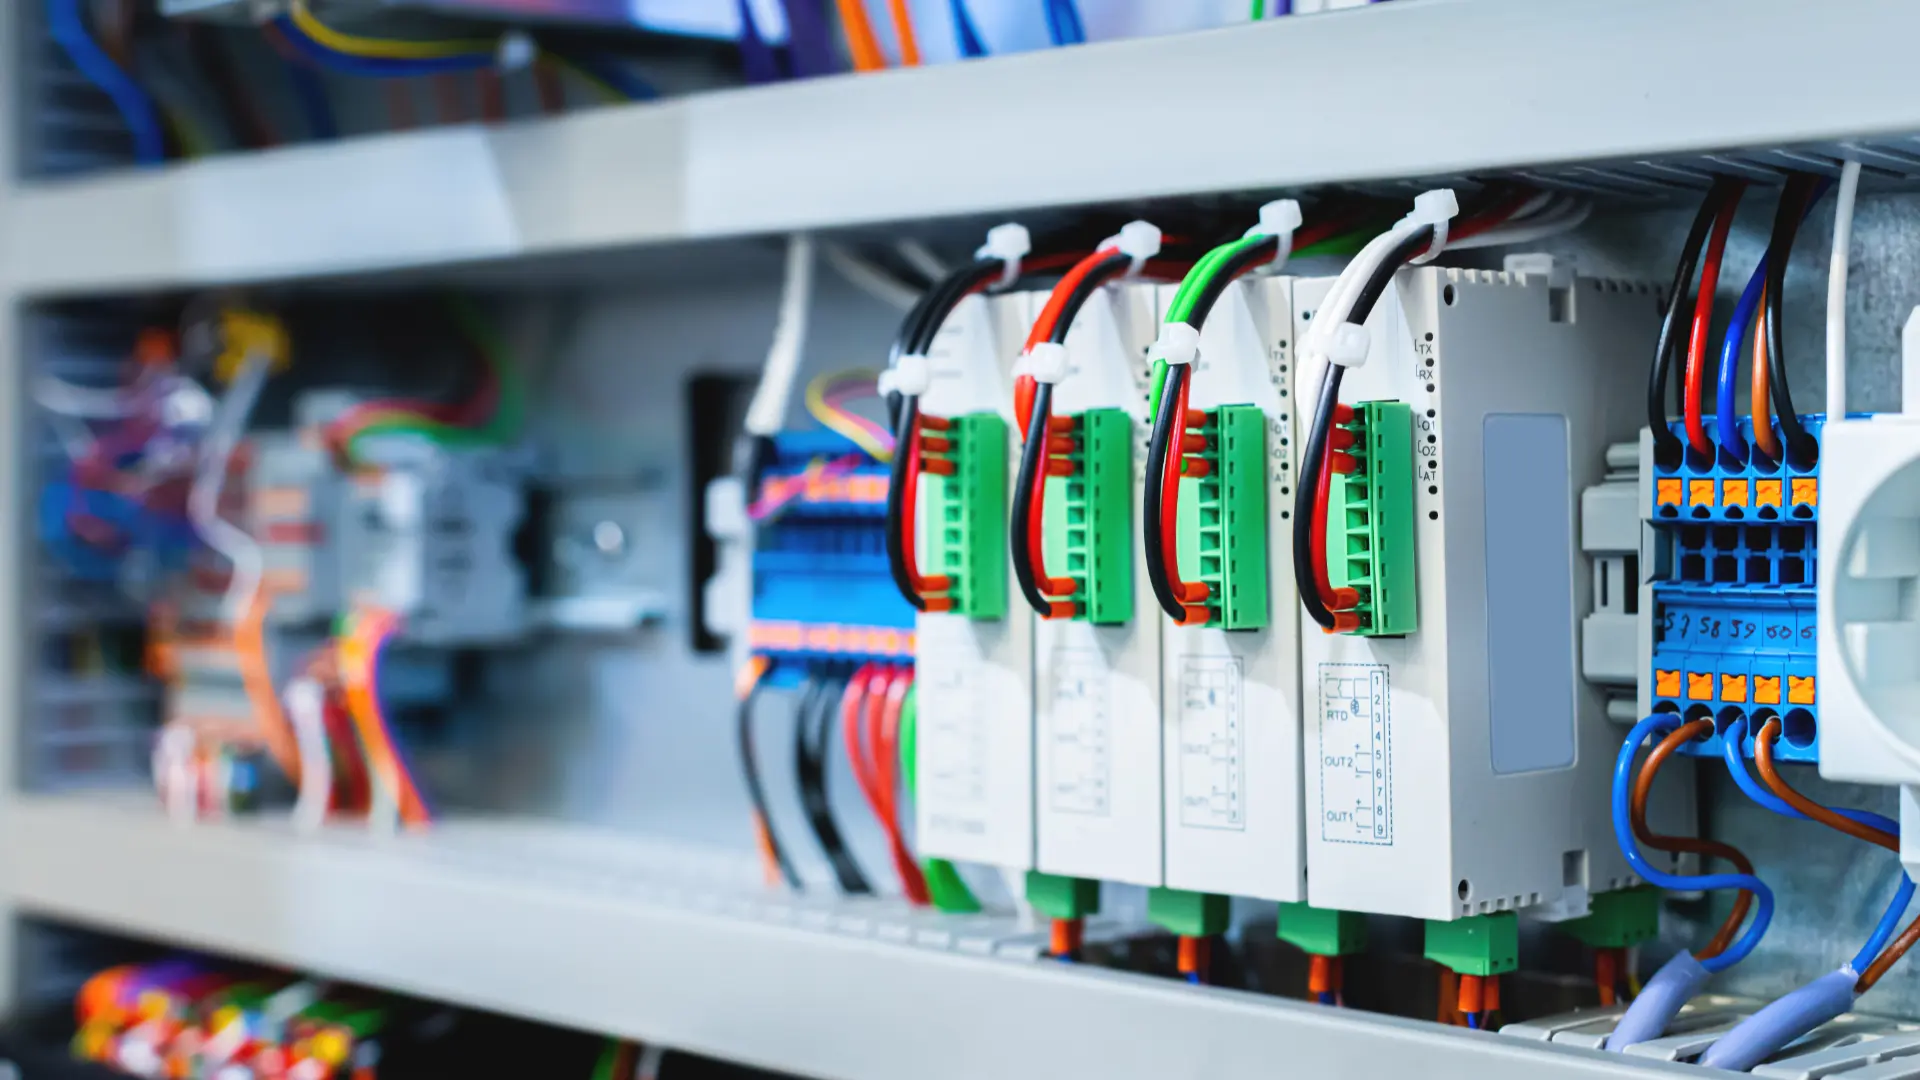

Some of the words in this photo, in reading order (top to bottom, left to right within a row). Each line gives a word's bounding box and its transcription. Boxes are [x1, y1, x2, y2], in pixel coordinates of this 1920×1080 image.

[1419, 344, 1432, 354] TX
[1419, 369, 1433, 380] RX
[1423, 470, 1436, 481] AT
[1700, 616, 1721, 638] 58
[1801, 626, 1816, 640] 6
[1375, 694, 1381, 705] 2
[1375, 712, 1381, 723] 3
[1376, 749, 1382, 760] 5
[1325, 756, 1353, 767] OUT2
[1376, 768, 1382, 779] 6
[1377, 786, 1383, 797] 7
[1326, 810, 1353, 822] OUT1
[1377, 805, 1383, 816] 8
[1377, 824, 1383, 835] 9
